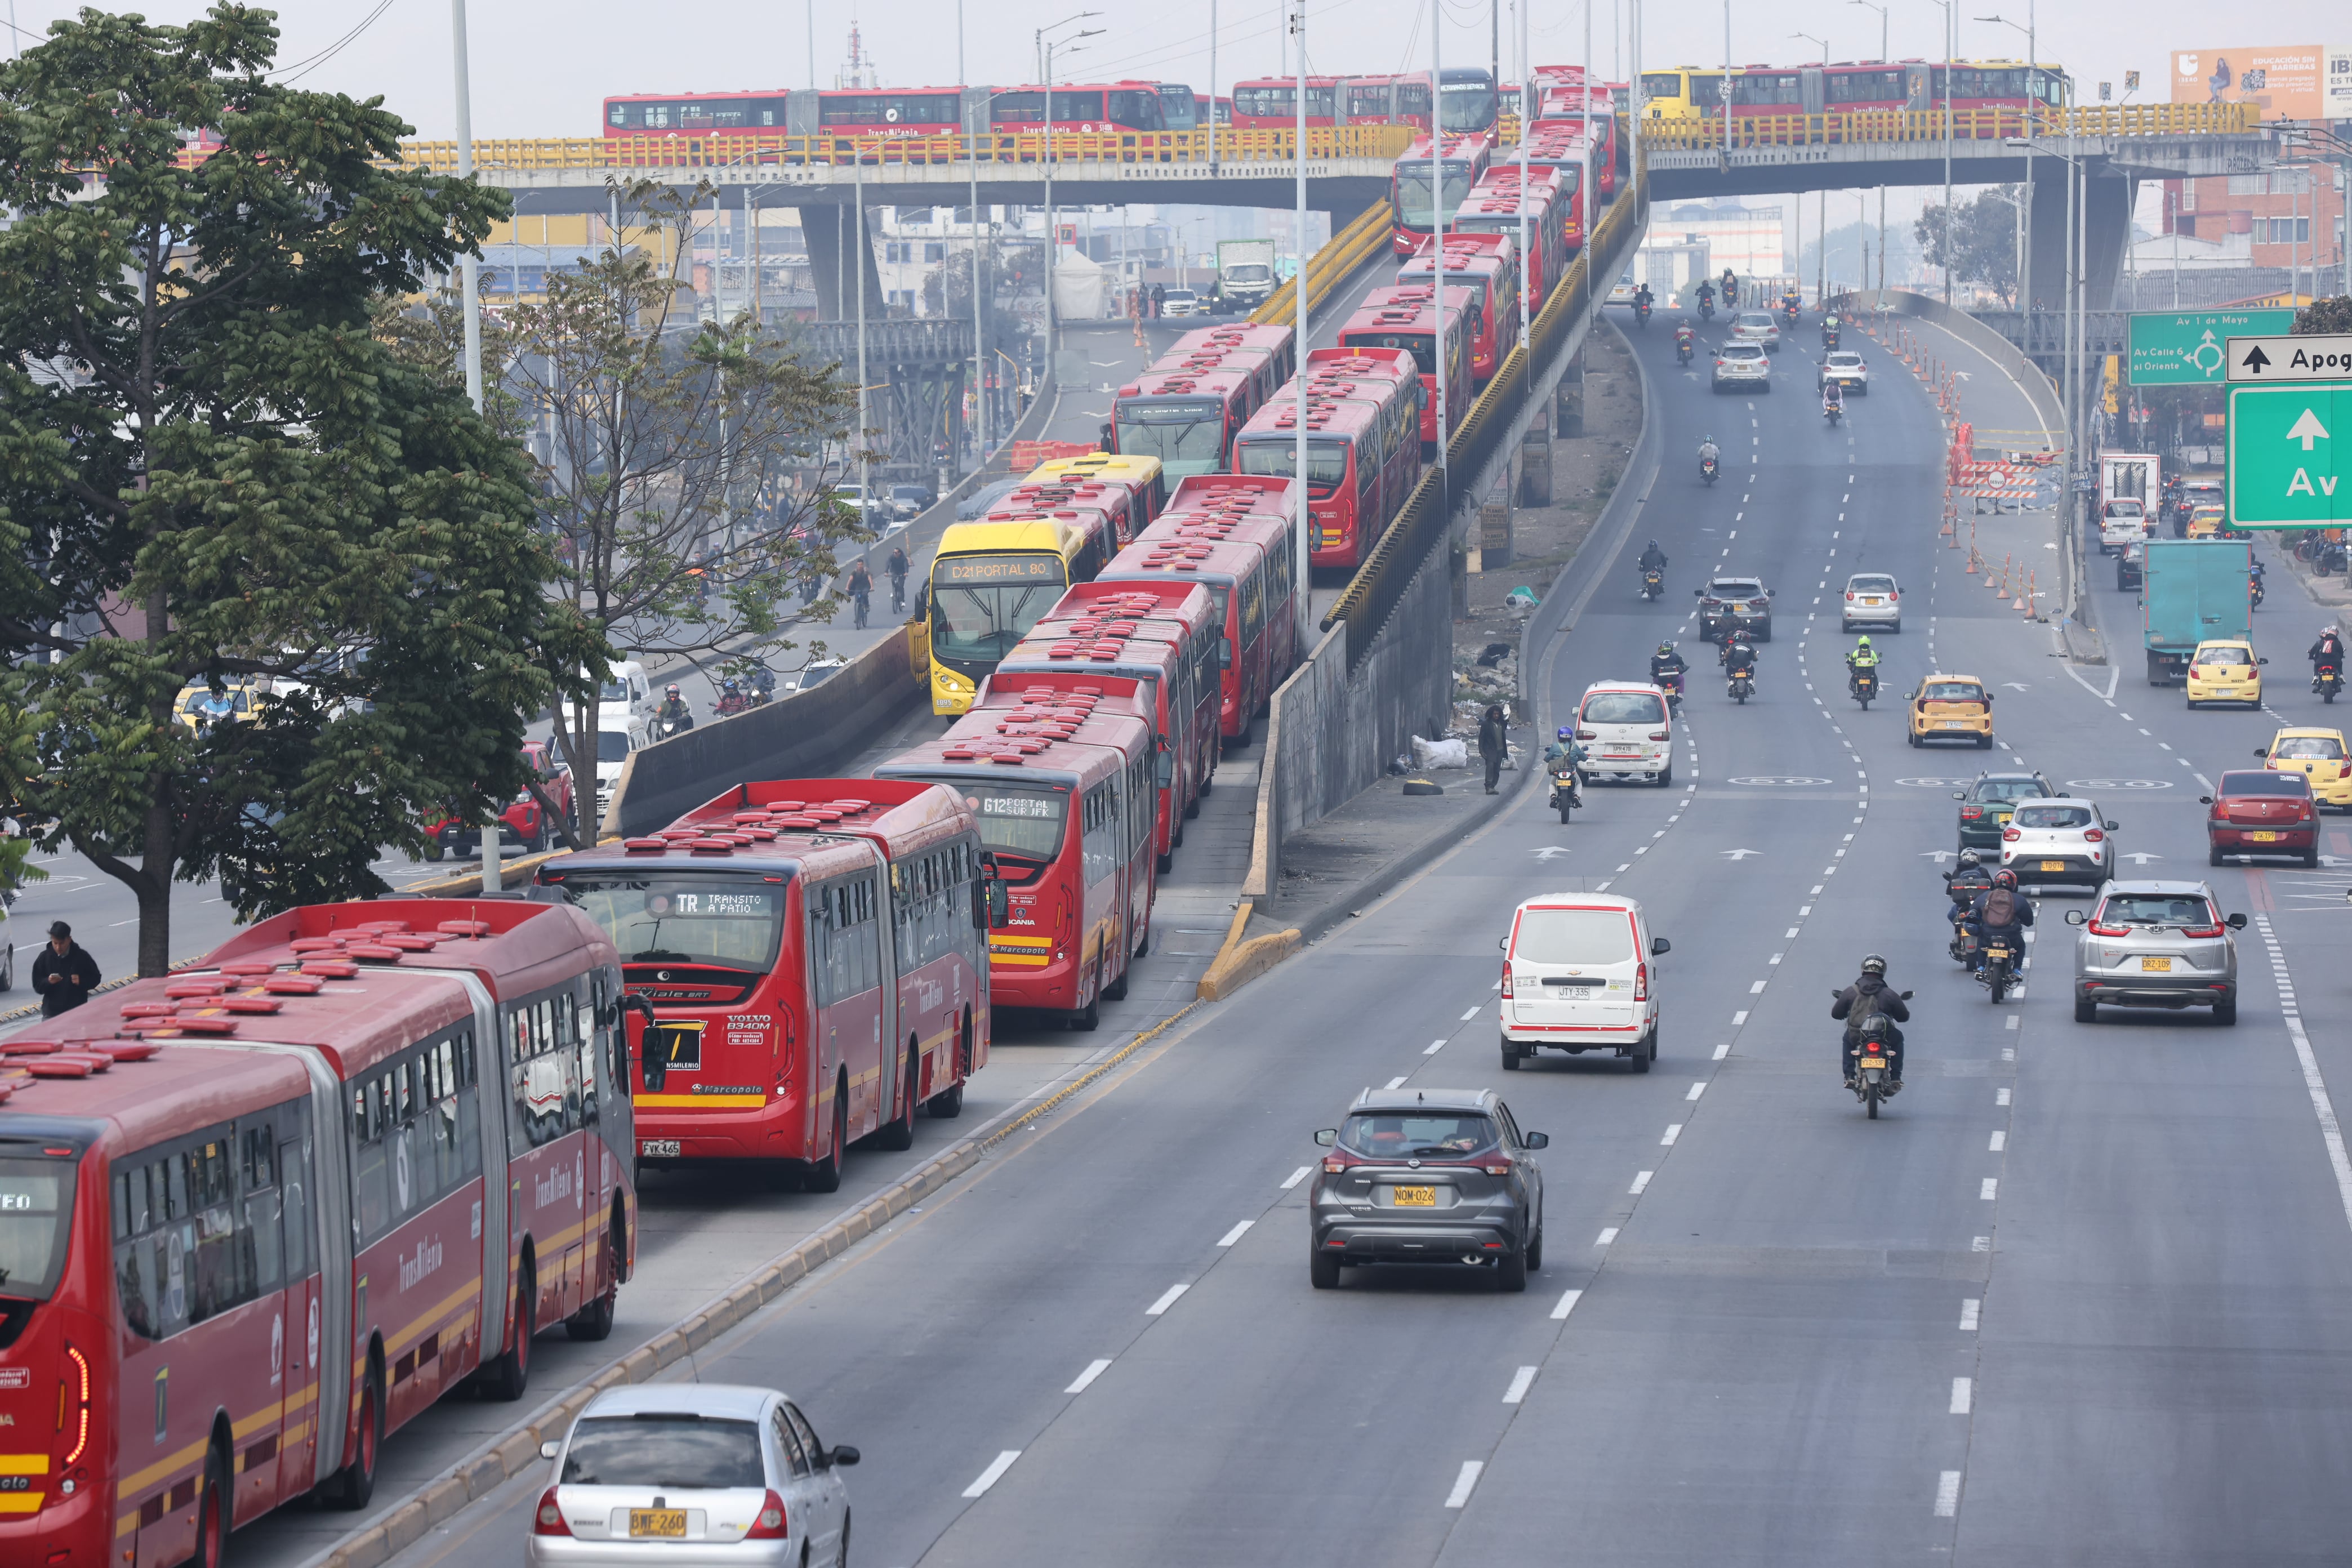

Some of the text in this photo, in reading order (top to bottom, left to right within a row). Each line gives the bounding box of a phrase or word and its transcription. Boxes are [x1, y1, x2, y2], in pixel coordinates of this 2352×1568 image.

[2253, 55, 2299, 65] EDUCACIÓN
[2176, 317, 2190, 326] Av
[2222, 315, 2248, 325] Mayo
[2286, 467, 2338, 496] Av
[952, 563, 1046, 578] D21 PORTAL 80
[984, 798, 1048, 813] G12 PORTAL
[1006, 807, 1049, 817] SUR JFK
[678, 894, 761, 912] TR TRANSITO
[709, 904, 751, 913] A PATIO
[2142, 960, 2170, 968] DRZ-109
[920, 979, 942, 1015] TransMilenio
[644, 1144, 679, 1153] FVK-465
[536, 1163, 571, 1210] TransMilenio
[399, 1233, 442, 1294] TransMilenio
[631, 1514, 684, 1530] BWF-260
